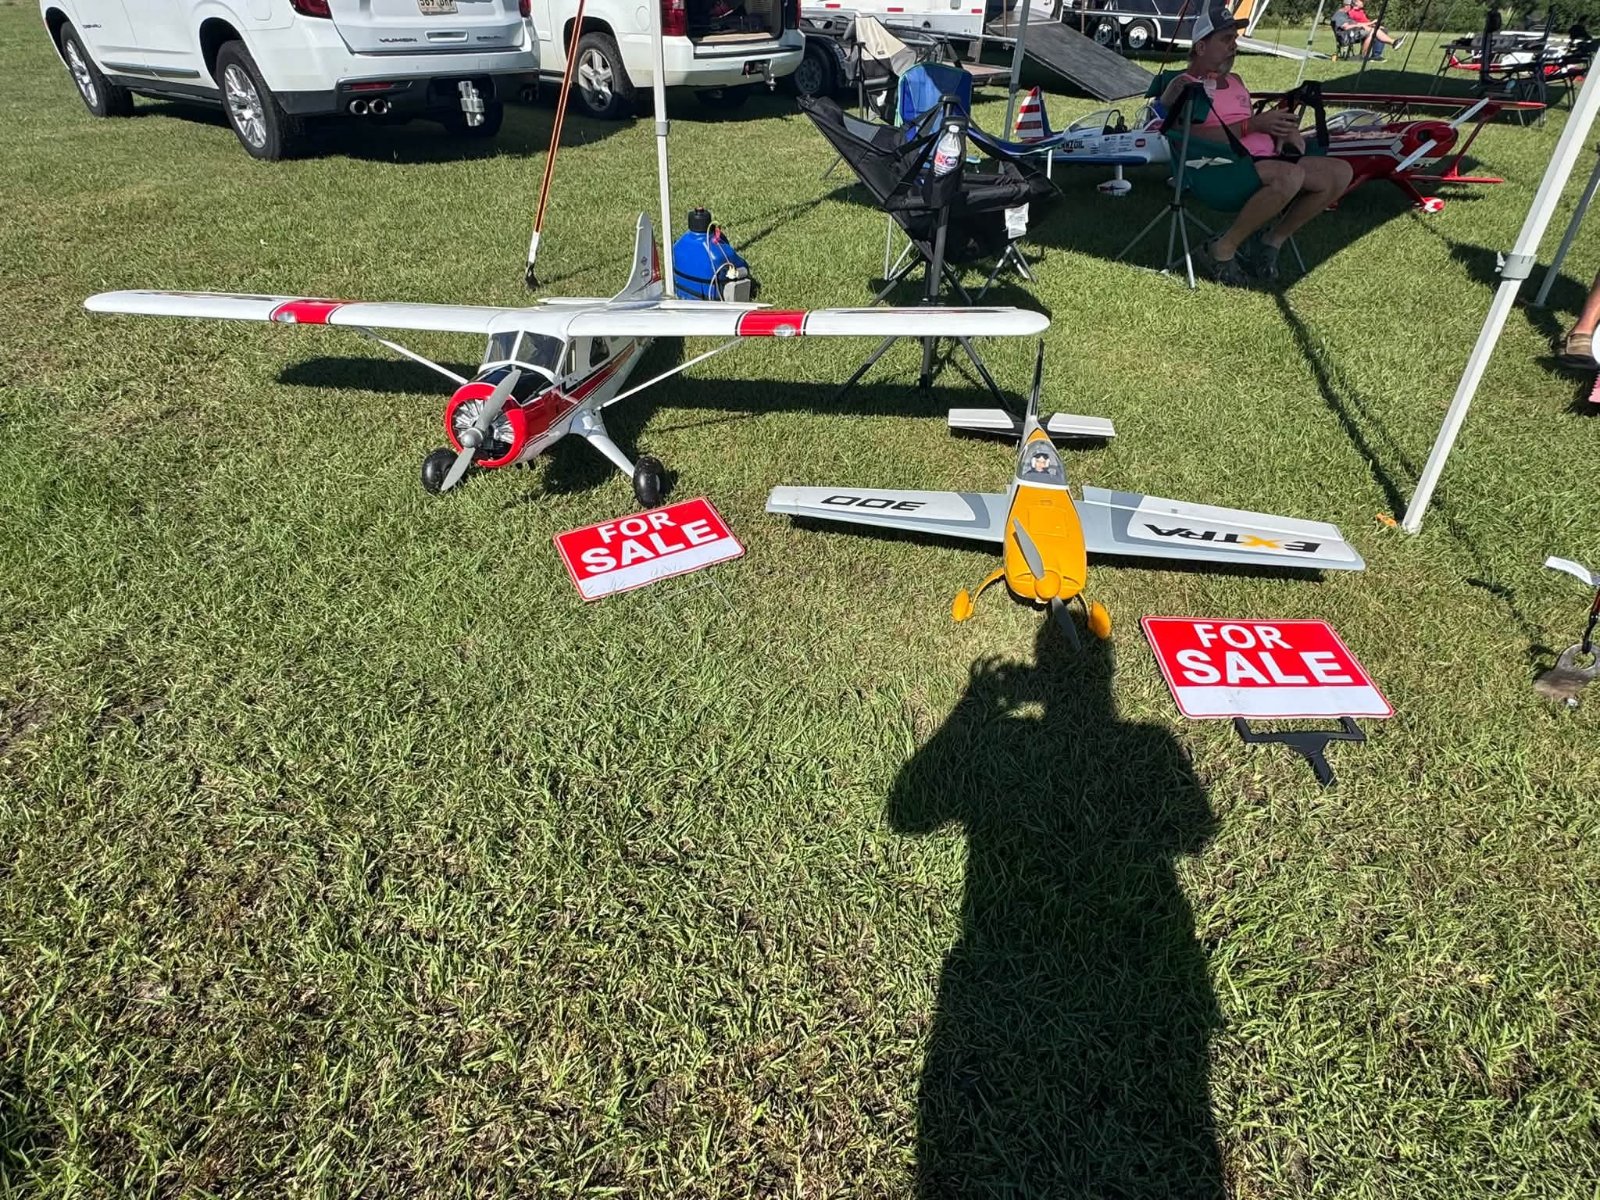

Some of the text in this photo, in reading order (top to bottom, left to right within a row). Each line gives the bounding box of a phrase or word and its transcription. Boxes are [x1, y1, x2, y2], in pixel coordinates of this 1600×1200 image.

[820, 495, 927, 512] 300
[596, 512, 677, 544] FOR
[1143, 523, 1322, 553] EXTRA
[580, 519, 719, 574] SALE
[1193, 623, 1294, 649] FOR
[1175, 649, 1354, 684] SALE
